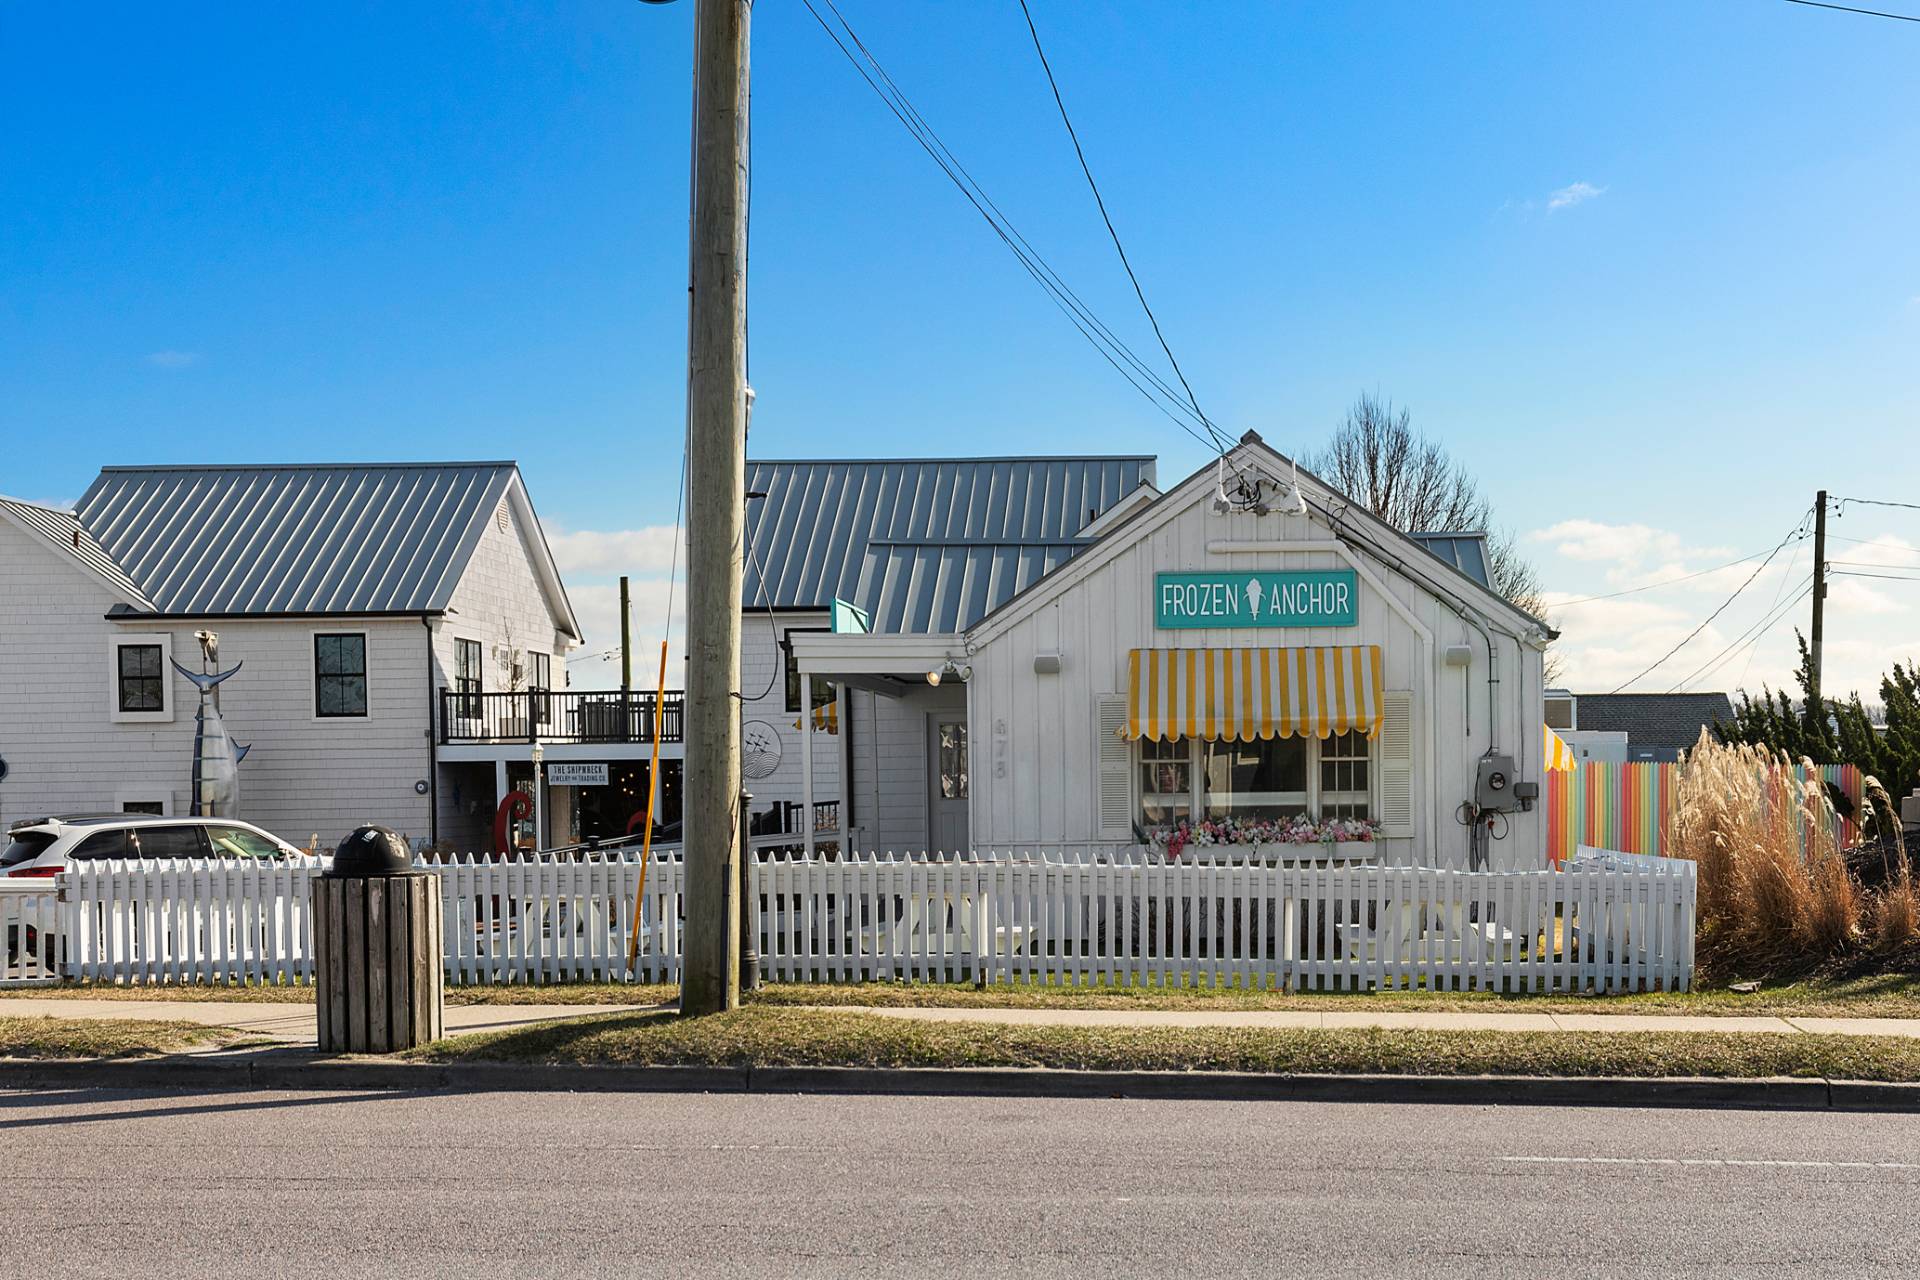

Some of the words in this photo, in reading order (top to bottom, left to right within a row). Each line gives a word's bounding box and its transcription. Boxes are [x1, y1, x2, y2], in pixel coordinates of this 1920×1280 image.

[1162, 583, 1239, 616] FROZEN
[1269, 582, 1350, 615] ANCHOR
[553, 765, 566, 775] THE
